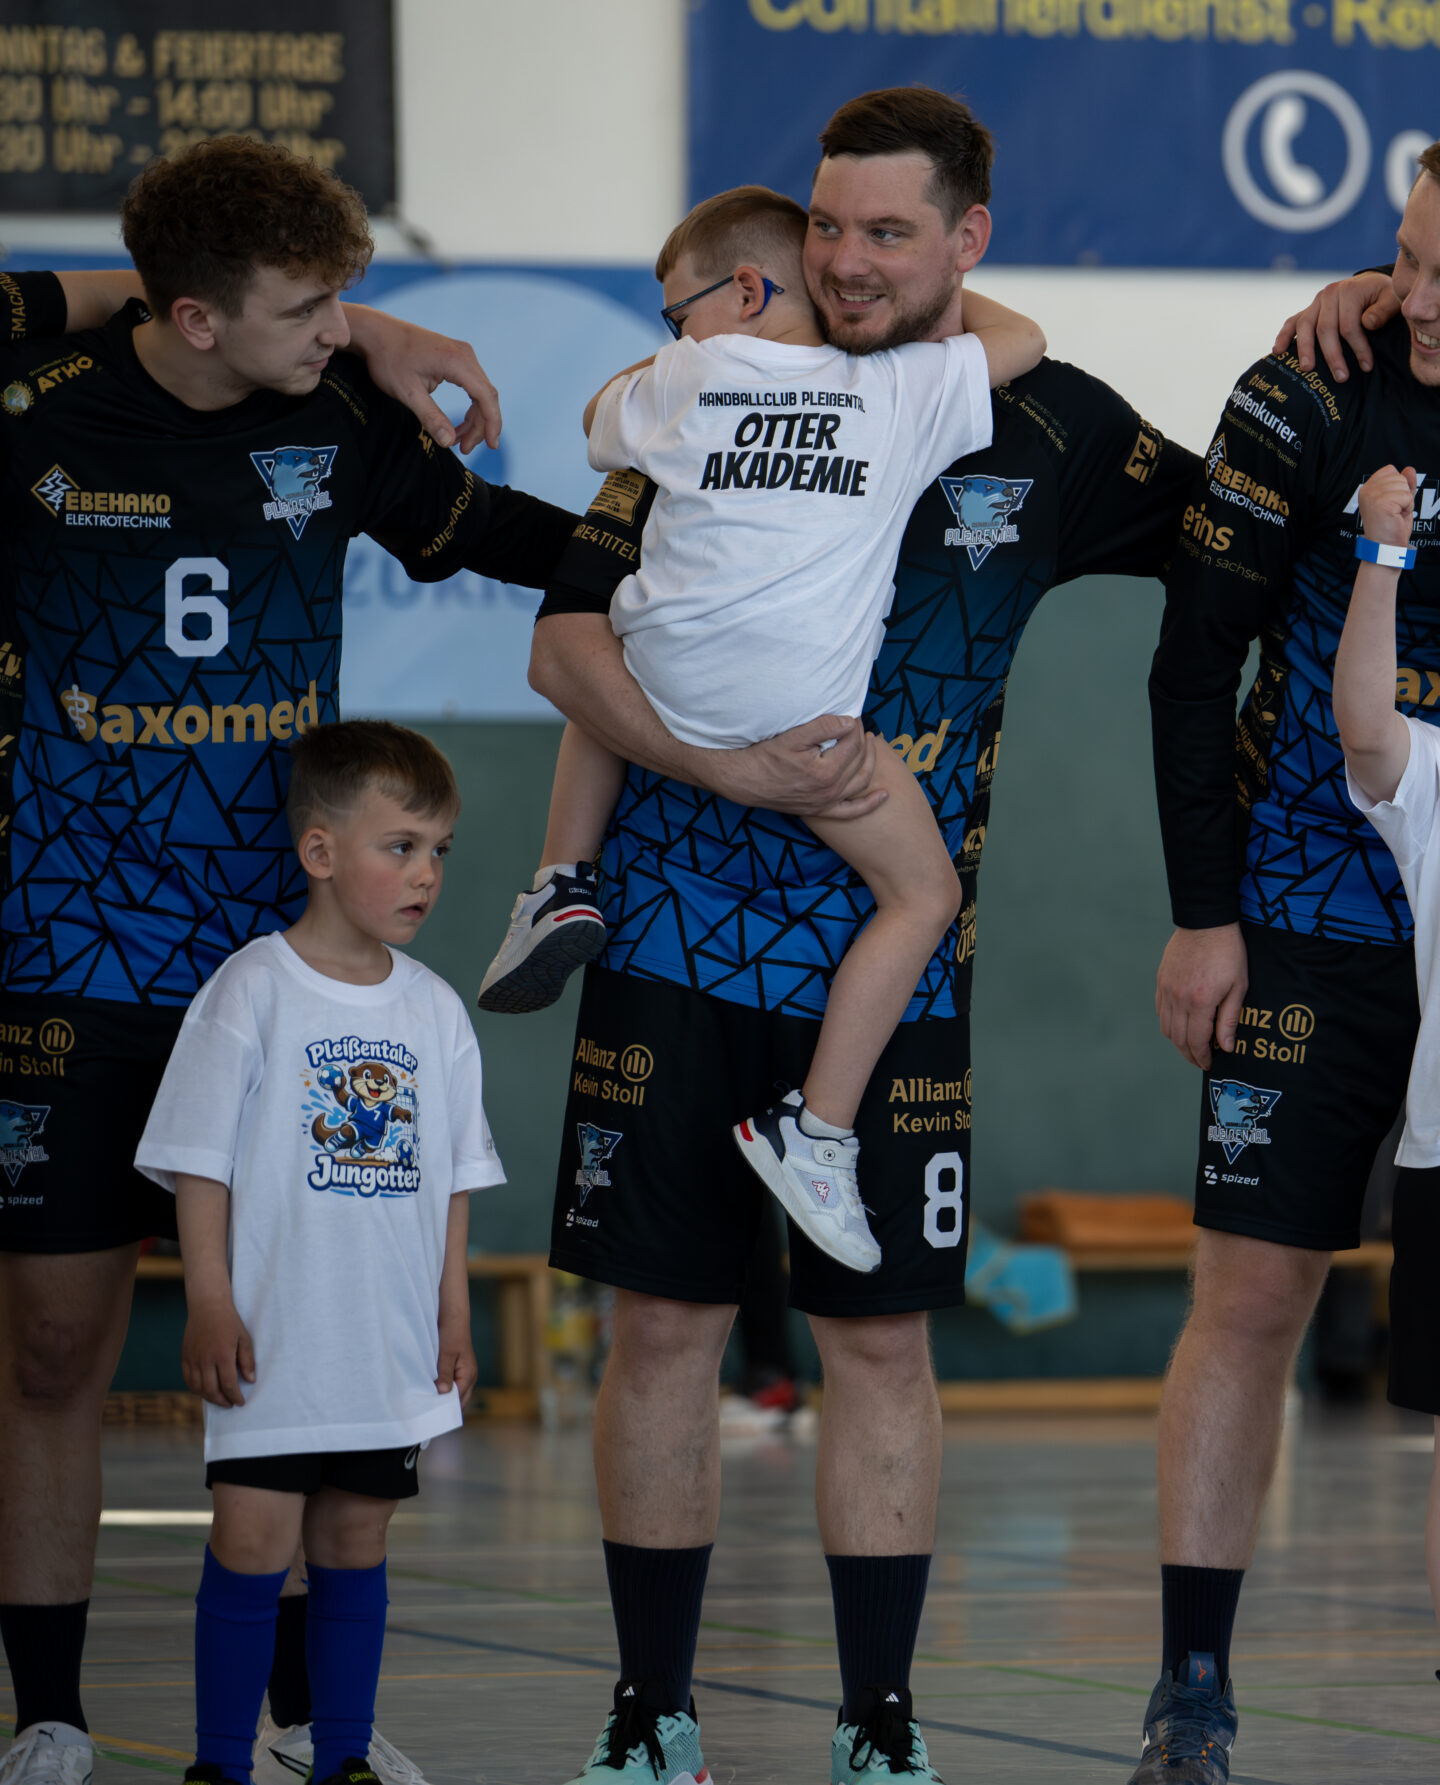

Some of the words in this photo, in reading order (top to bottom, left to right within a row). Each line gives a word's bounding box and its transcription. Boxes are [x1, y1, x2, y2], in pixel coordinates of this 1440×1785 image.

[153, 28, 345, 84] FEIERTAGE
[52, 74, 121, 126] Uhr
[257, 80, 335, 131] Uhr
[53, 122, 123, 174] Uhr
[699, 391, 797, 407] HANDBALLCLUB
[734, 412, 841, 450] OTTER
[699, 451, 870, 497] AKADEMIE
[1214, 461, 1291, 517] EBEHAKO
[65, 491, 171, 514] EBEHAKO
[65, 514, 172, 529] ELEKTROTECHNIK
[1210, 480, 1287, 528] ELEKTROTECHNIK
[1183, 502, 1235, 552] eins
[1215, 553, 1268, 586] sachsen
[165, 557, 229, 657] 6
[60, 680, 320, 744] Saxomed
[19, 1054, 65, 1077] Stoll
[305, 1036, 418, 1075] Pleißentaler
[576, 1037, 617, 1070] Allianz
[1253, 1037, 1307, 1065] Stoll
[574, 1072, 598, 1097] Kevin
[601, 1080, 646, 1106] Stoll
[888, 1077, 962, 1103] Allianz
[893, 1112, 950, 1133] Kevin
[308, 1153, 420, 1197] Jungotter
[1221, 1172, 1260, 1187] spized
[923, 1151, 964, 1249] 8
